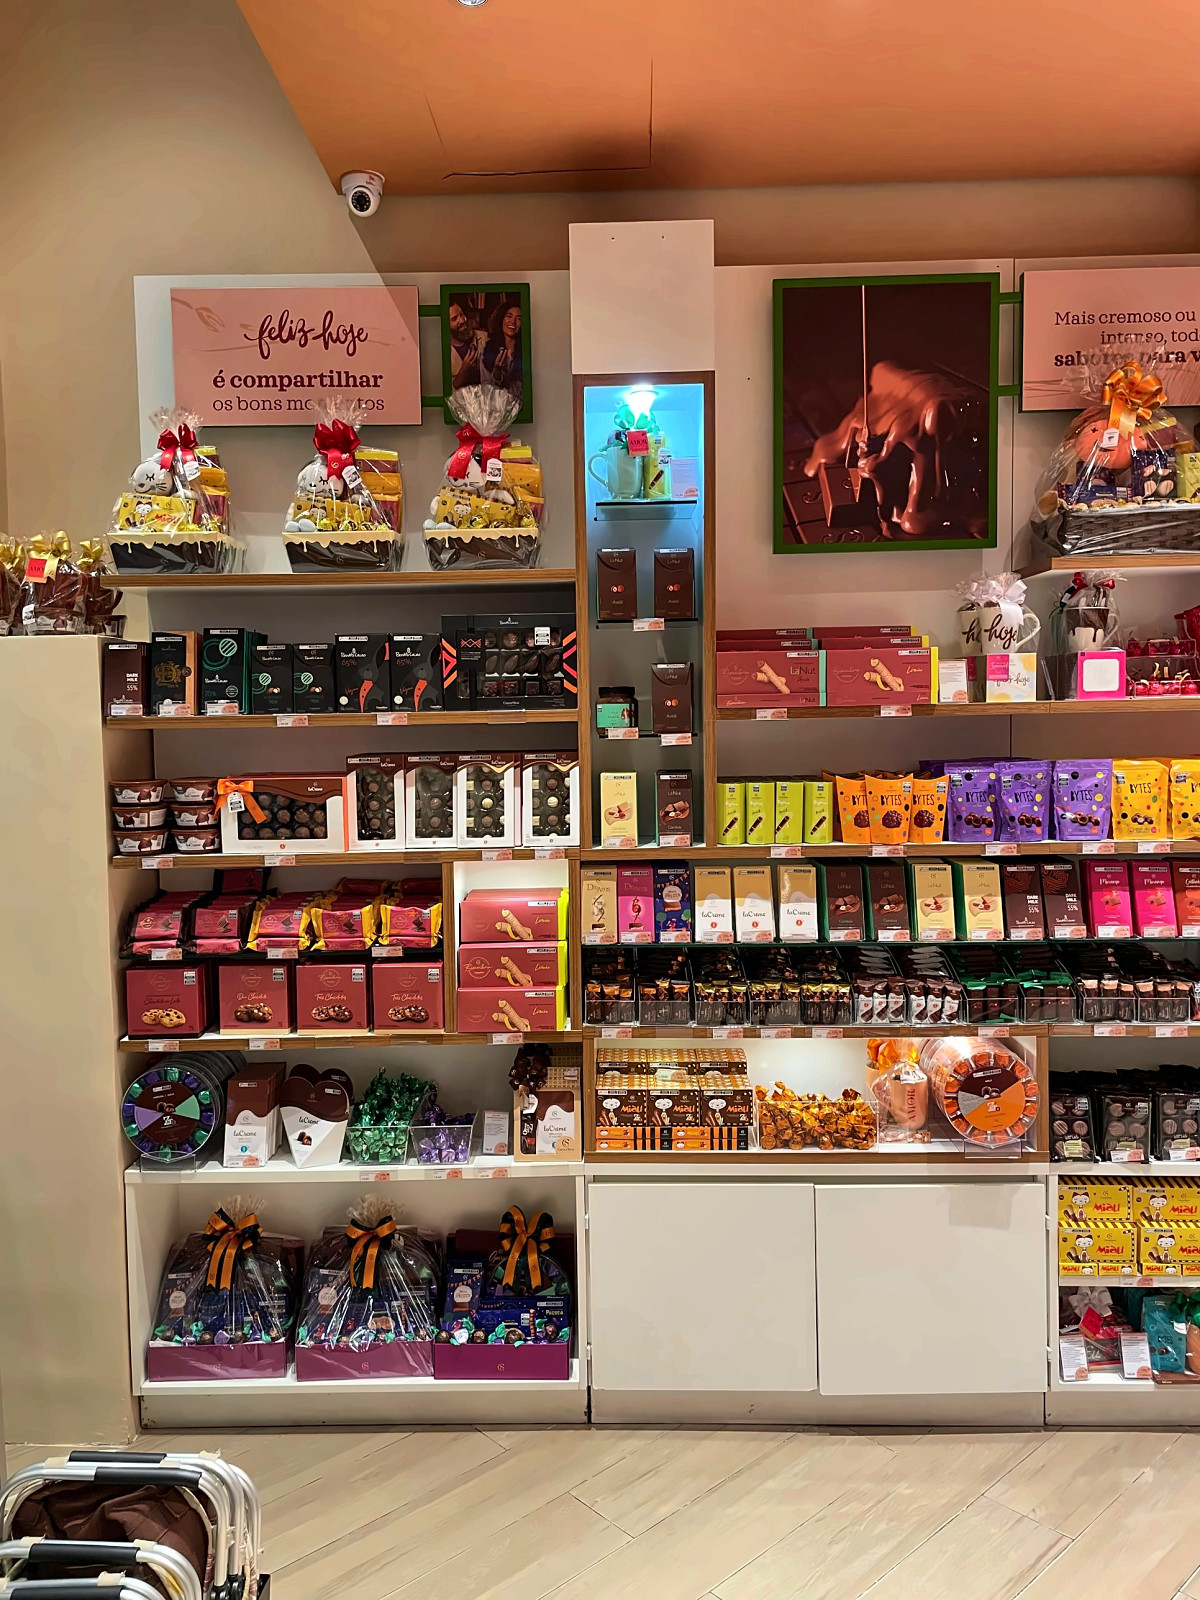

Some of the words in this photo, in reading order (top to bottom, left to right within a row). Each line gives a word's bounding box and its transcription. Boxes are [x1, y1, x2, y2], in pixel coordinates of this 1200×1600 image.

[1054, 311, 1095, 325] Mais
[1098, 311, 1172, 324] cremoso
[1175, 311, 1196, 322] ou
[244, 309, 316, 360] feliz
[312, 310, 368, 357] hoje
[1171, 328, 1200, 342] tod
[212, 369, 225, 388] é
[230, 370, 383, 392] compartilhar
[212, 399, 233, 411] os
[236, 396, 282, 411] bons
[287, 397, 385, 411] motos
[984, 613, 1017, 650] hoje
[1129, 782, 1152, 794] BYTES
[880, 794, 902, 806] BYTES
[965, 790, 987, 803] BYTES
[1014, 790, 1035, 803] BYTES
[1070, 789, 1092, 802] BYTES
